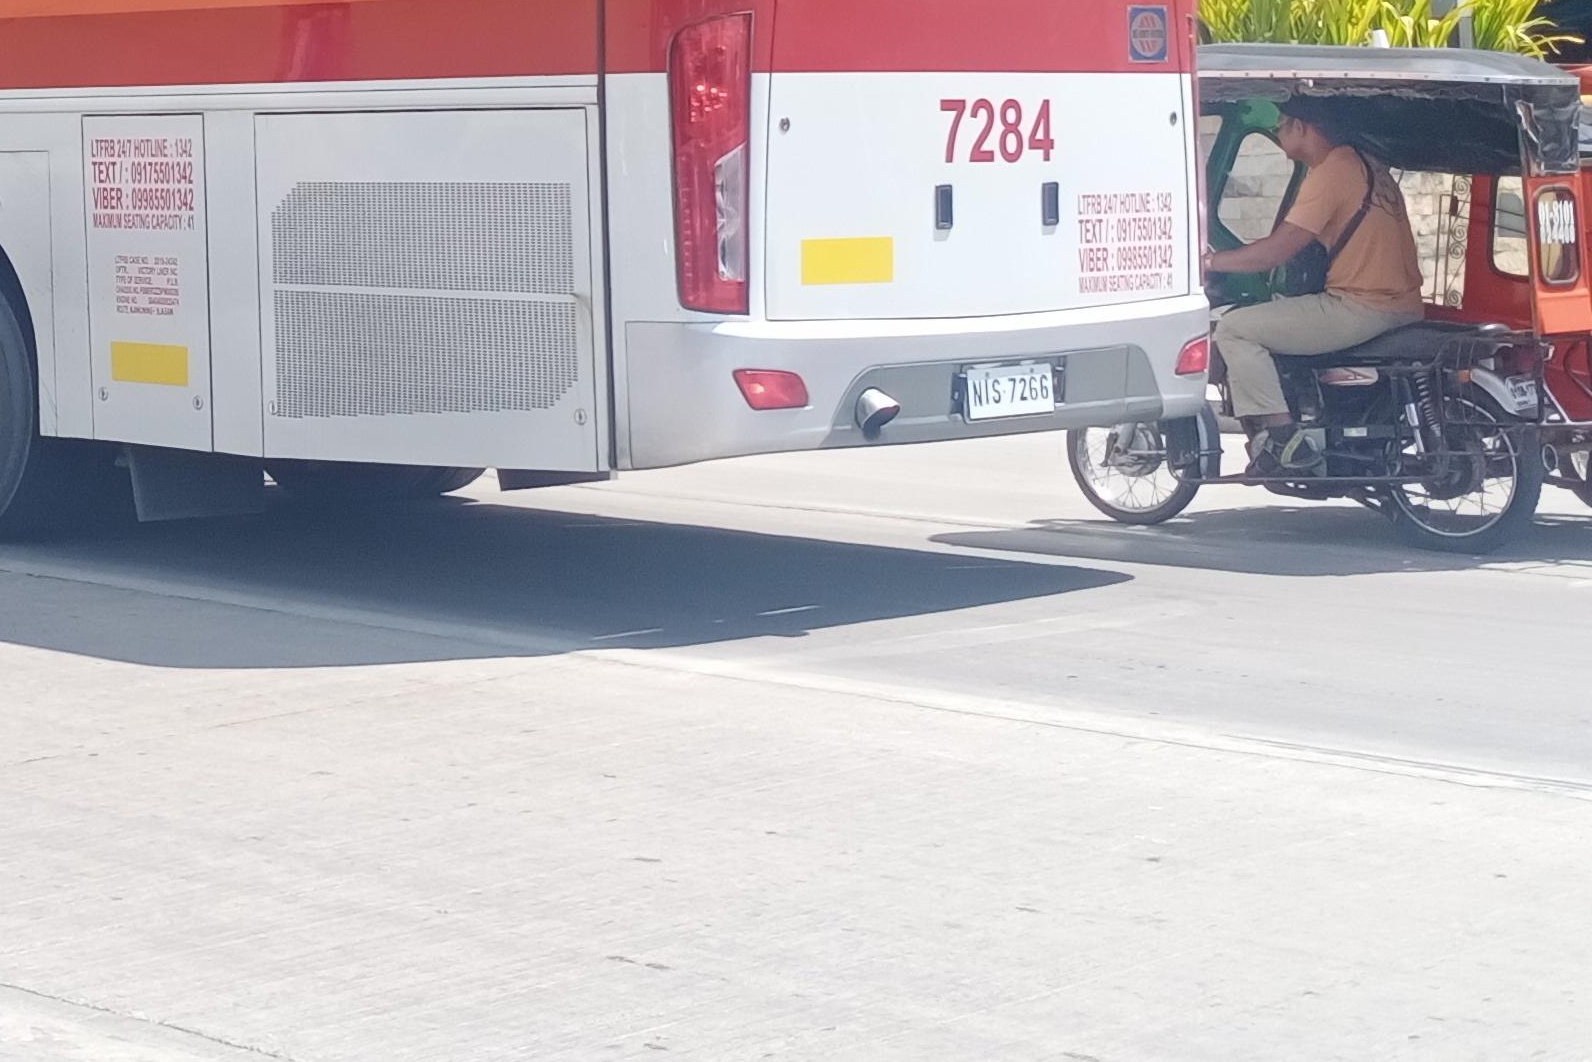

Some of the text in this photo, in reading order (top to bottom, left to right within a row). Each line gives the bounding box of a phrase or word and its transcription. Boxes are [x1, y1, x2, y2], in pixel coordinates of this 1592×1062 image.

[940, 98, 1054, 163] 7284
[91, 139, 116, 158] LTFRB
[134, 138, 168, 158] HOTLINE
[175, 138, 192, 158] 1342
[92, 161, 117, 184] TEXT
[131, 161, 193, 184] 09175501342
[92, 188, 123, 210] VIBER
[131, 188, 194, 211] 09985501342
[1078, 194, 1101, 215] LTFRB
[1120, 192, 1151, 214] HOTLINE
[1157, 192, 1172, 212] 1342
[93, 213, 122, 229] MAXIMUM
[123, 213, 150, 229] SEATING
[151, 214, 182, 230] CAPACITY
[1078, 219, 1103, 244] TEXT
[1117, 216, 1172, 242] 09175501342
[1078, 248, 1109, 272] VIBER
[1117, 244, 1172, 271] 09985501342
[1079, 276, 1107, 293] MAXIMUM
[1109, 274, 1133, 292] SEATING
[1135, 273, 1162, 291] CAPACITY
[972, 374, 1049, 407] NIS 7266
